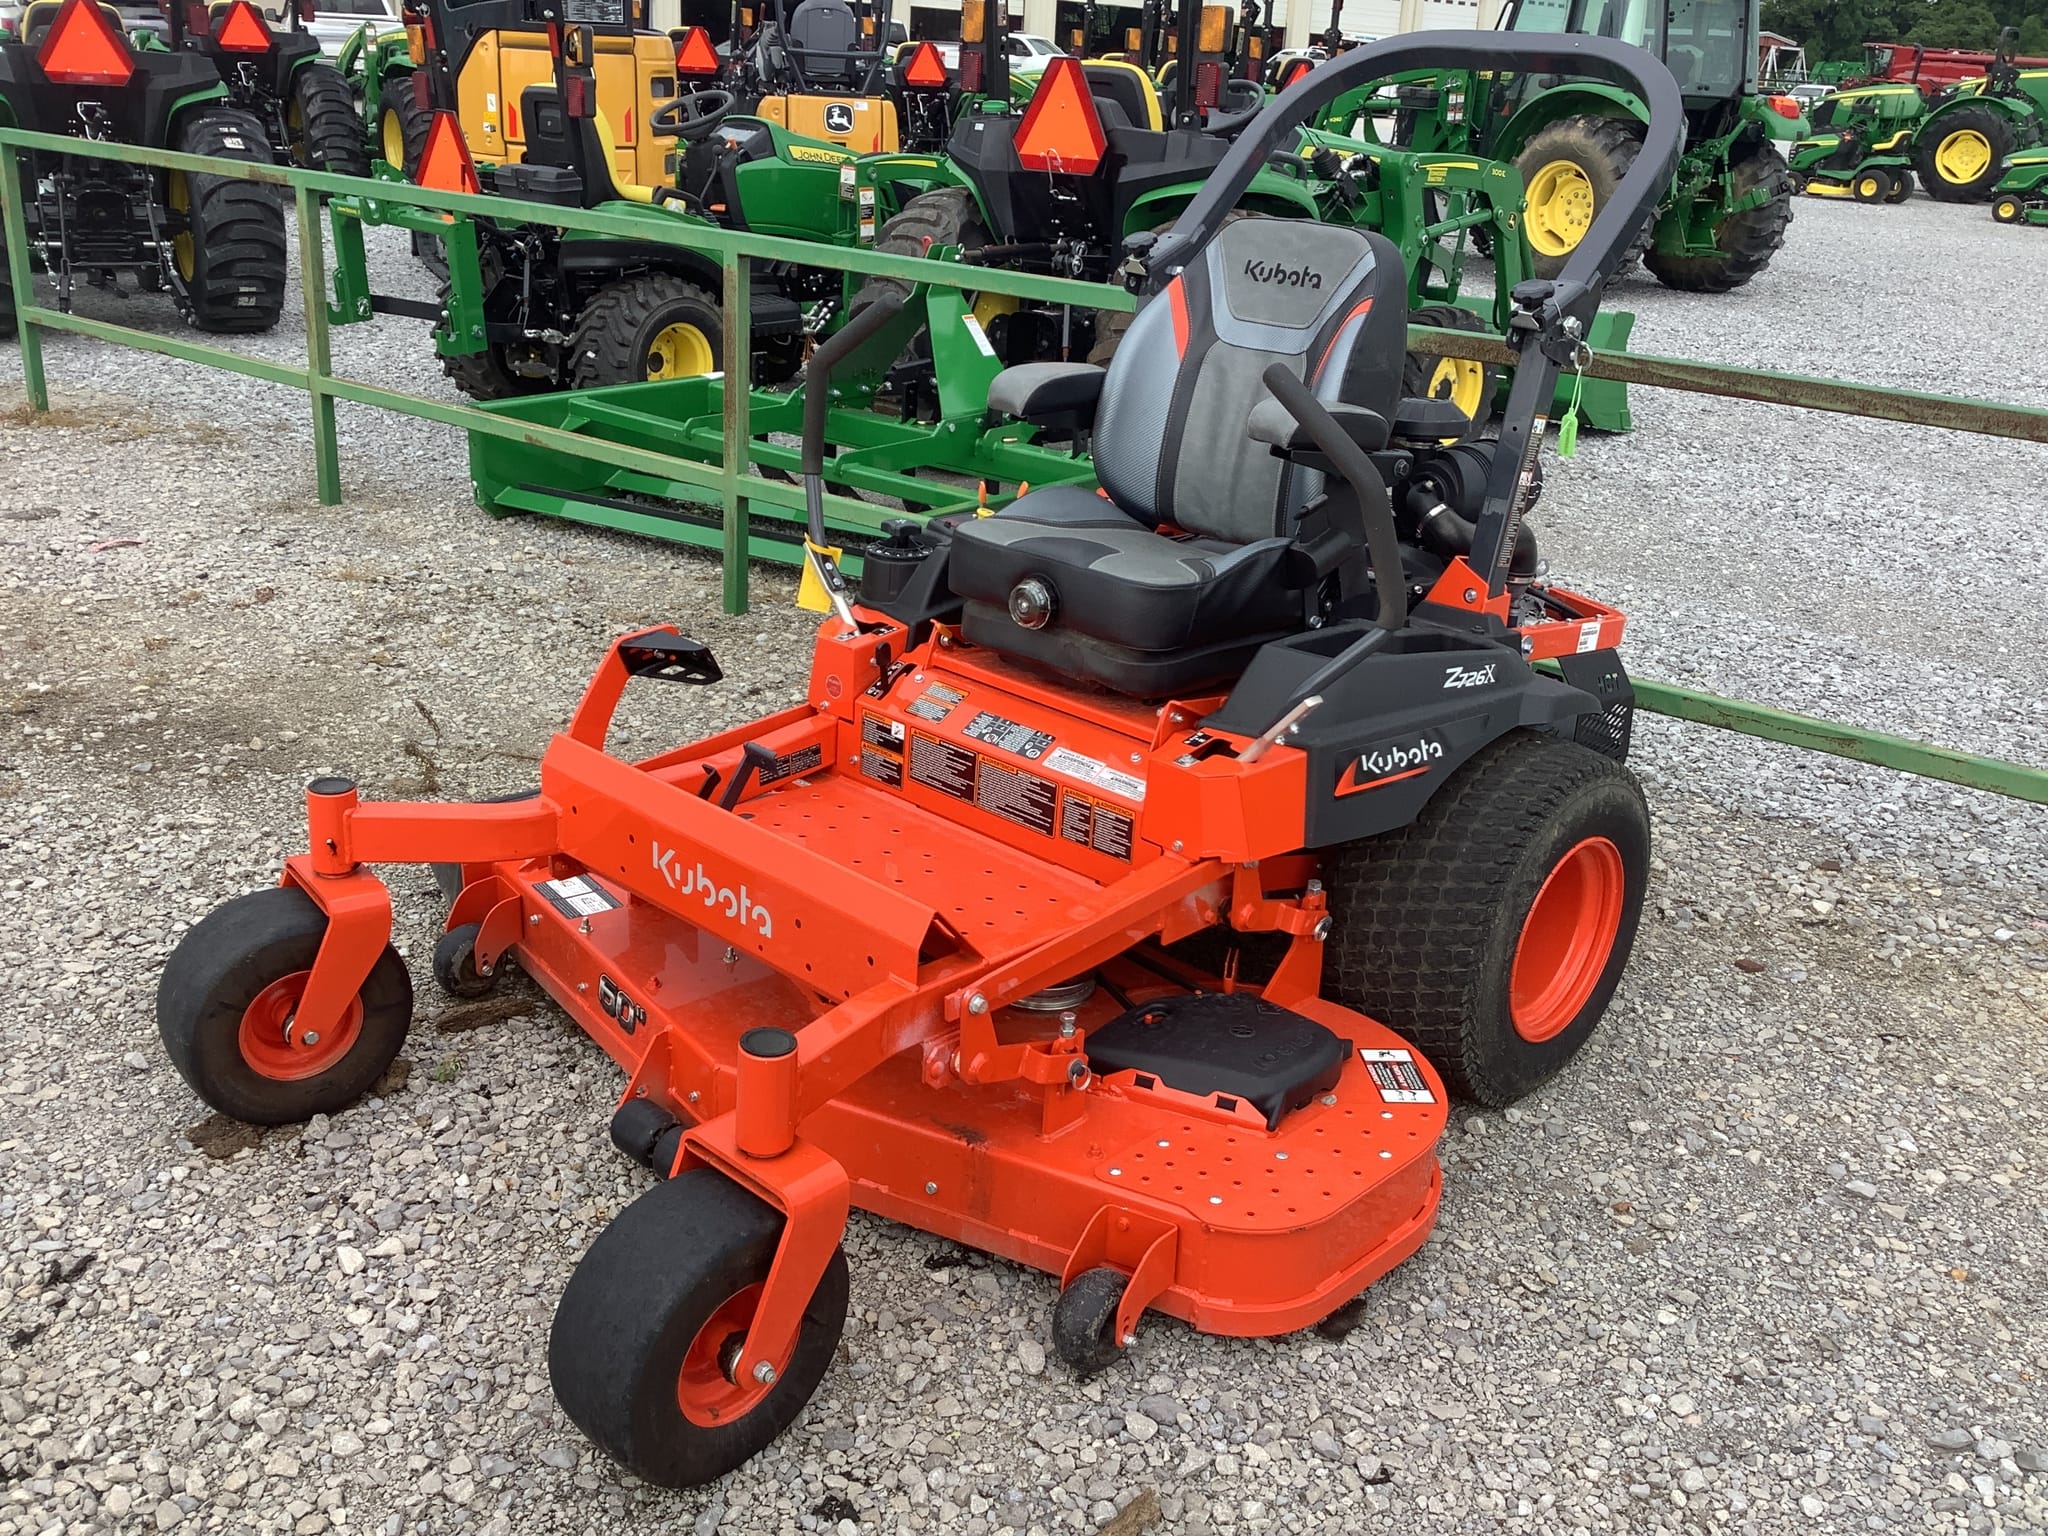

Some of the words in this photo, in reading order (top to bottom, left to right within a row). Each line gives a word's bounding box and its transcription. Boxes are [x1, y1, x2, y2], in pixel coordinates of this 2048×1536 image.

[798, 149, 823, 161] JOHN
[824, 152, 844, 163] DEE
[1244, 259, 1323, 290] Kubota
[1361, 739, 1443, 774] Kubota
[652, 840, 772, 938] Kubota
